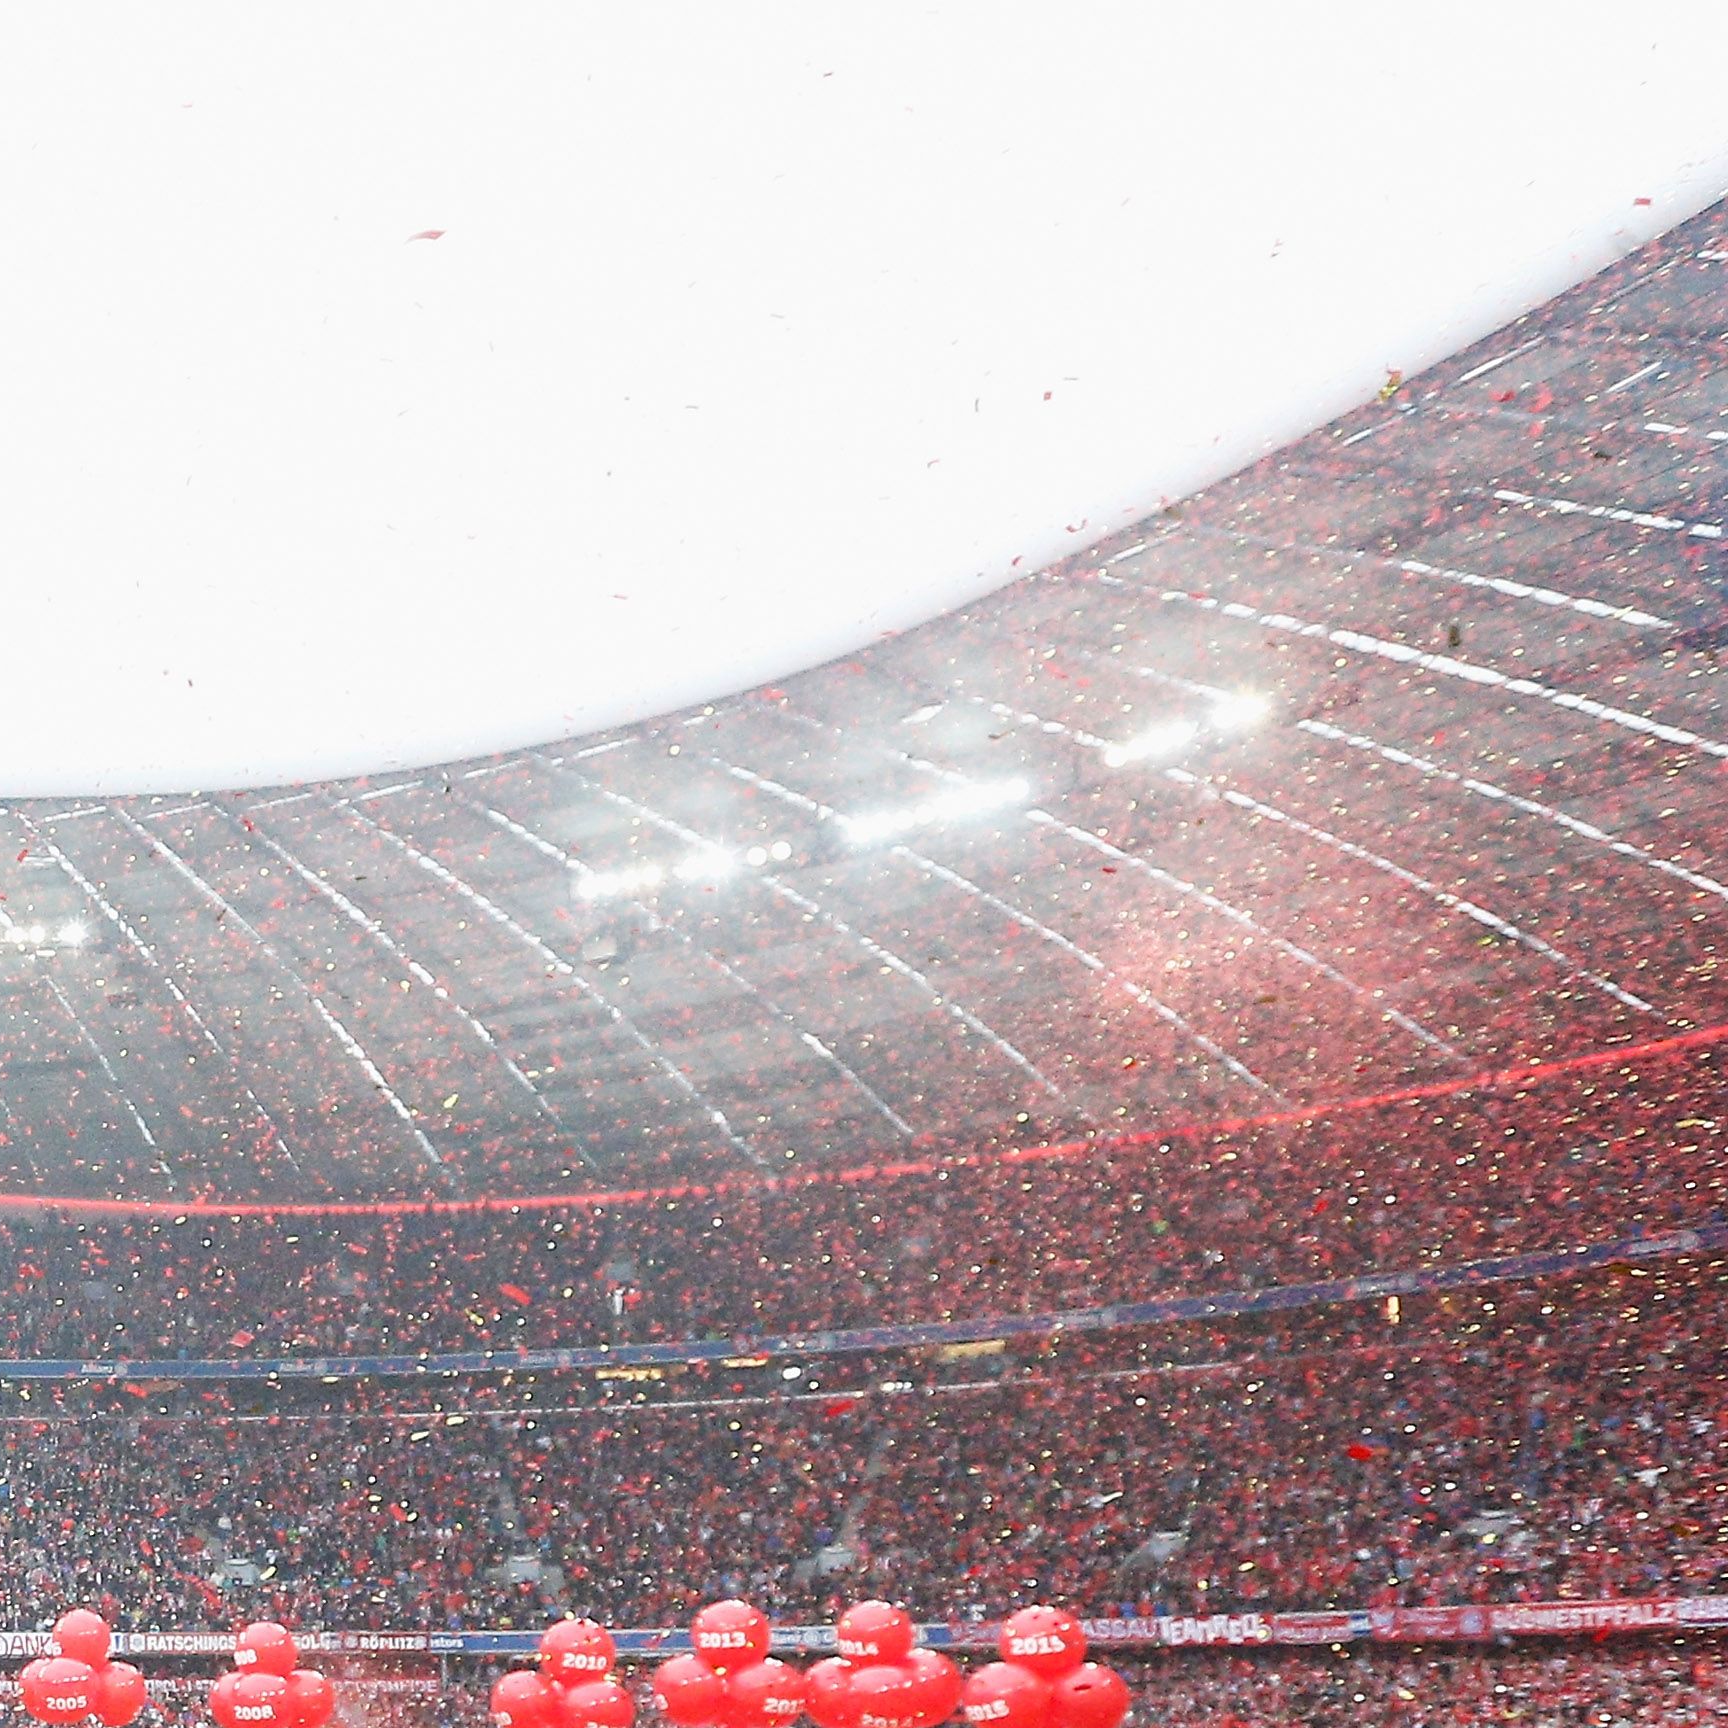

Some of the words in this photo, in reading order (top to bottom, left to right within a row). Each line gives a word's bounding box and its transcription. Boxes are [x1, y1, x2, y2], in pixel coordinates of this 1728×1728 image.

[699, 1632, 746, 1649] 2013
[1010, 1636, 1066, 1655] 2015
[562, 1652, 608, 1671] 2010
[46, 1696, 88, 1711] 2005
[233, 1705, 273, 1721] 2008
